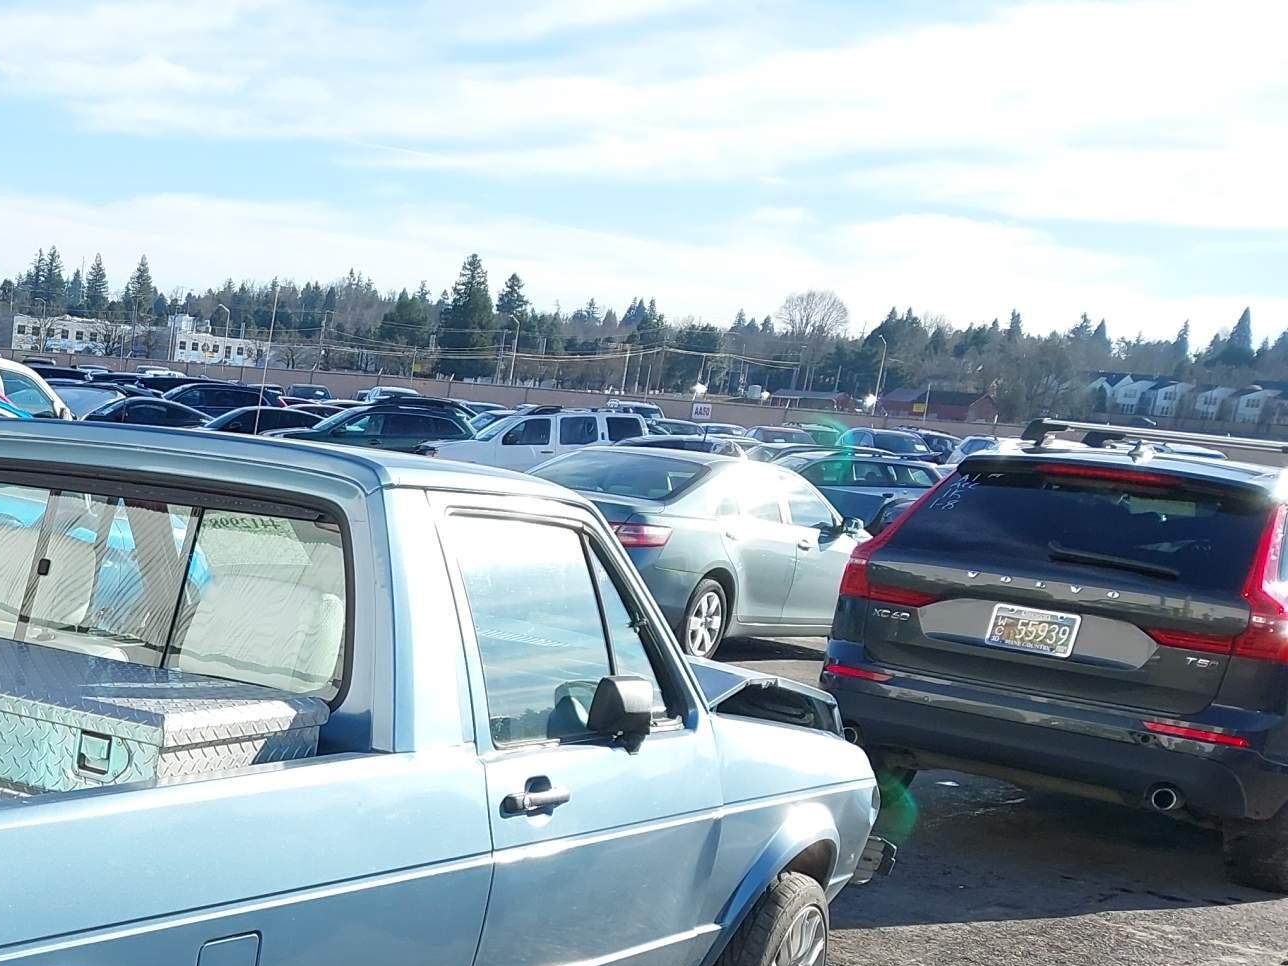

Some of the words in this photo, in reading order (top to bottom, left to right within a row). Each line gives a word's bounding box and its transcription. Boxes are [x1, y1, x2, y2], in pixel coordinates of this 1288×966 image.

[968, 570, 1120, 600] VOLVO
[872, 608, 911, 621] XC60
[1015, 619, 1070, 646] 55939
